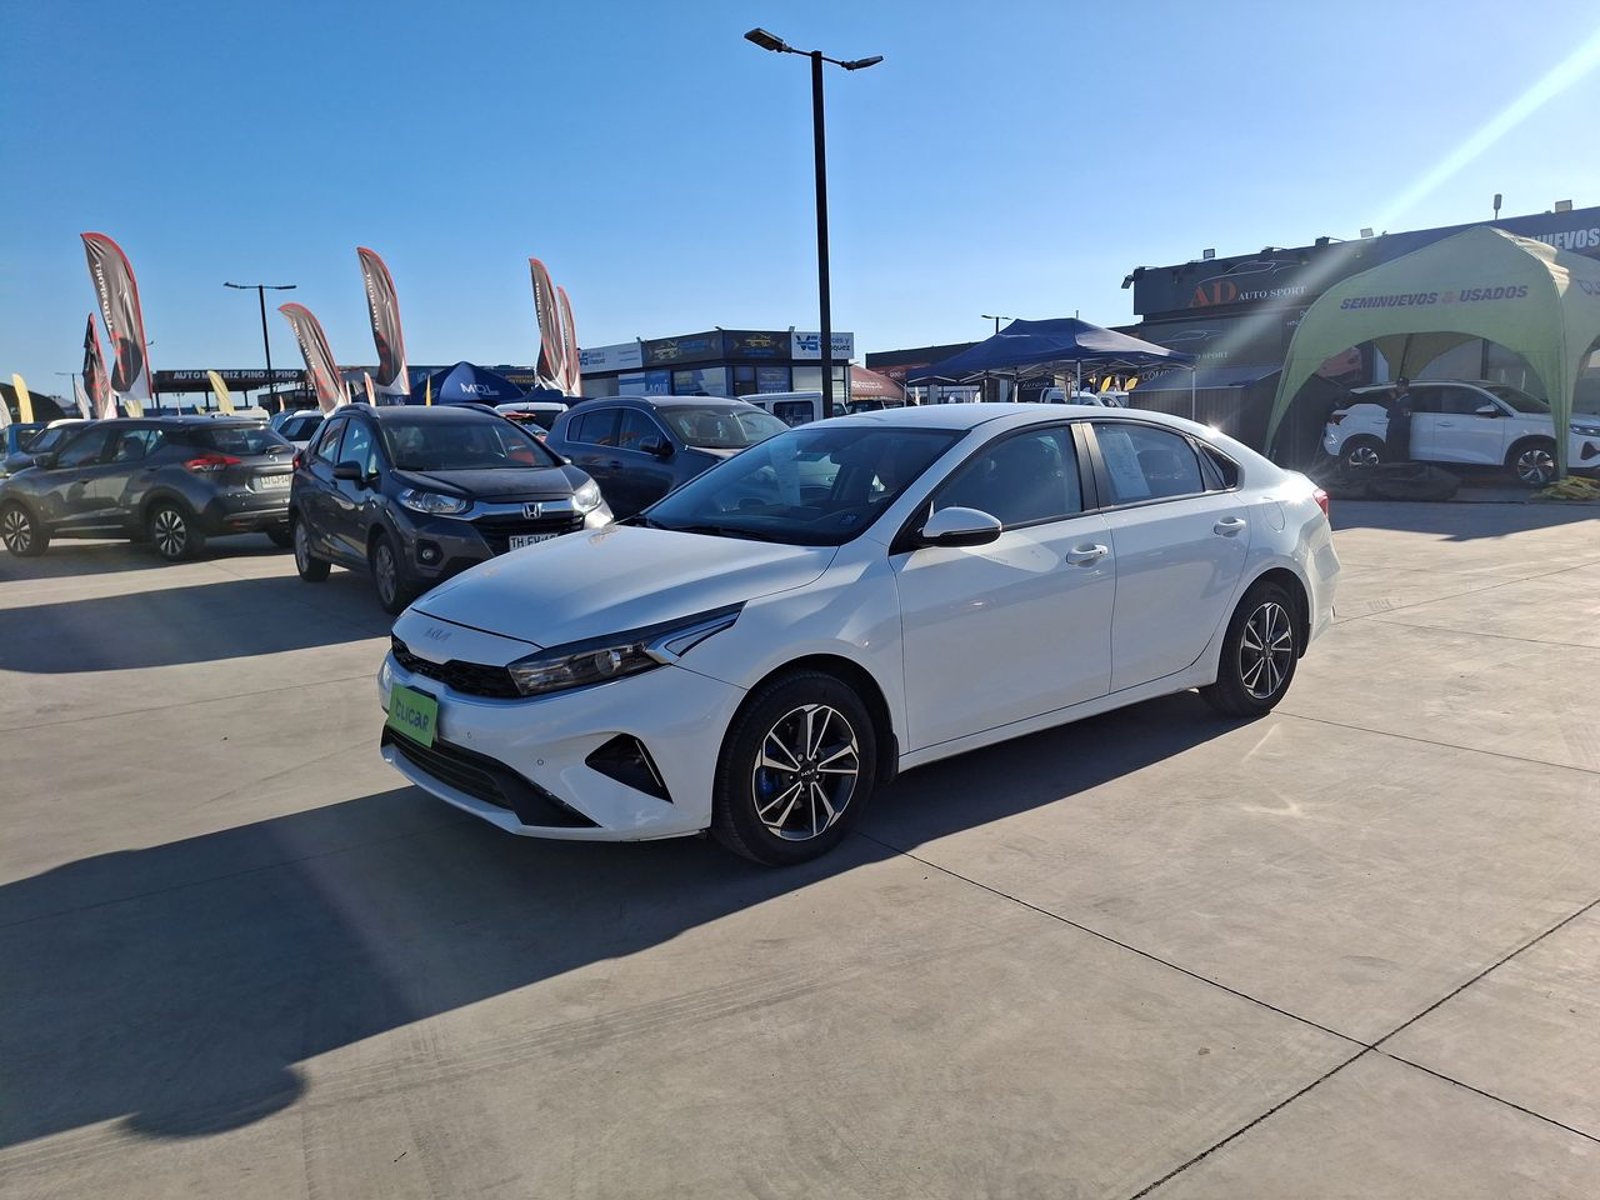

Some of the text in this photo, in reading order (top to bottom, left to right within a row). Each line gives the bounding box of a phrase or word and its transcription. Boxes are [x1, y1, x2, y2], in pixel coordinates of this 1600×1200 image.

[1188, 280, 1307, 308] AD AUTO SPORT
[1340, 292, 1438, 310] SEMINUEVOS
[1459, 285, 1529, 302] USADOS
[241, 370, 265, 379] PINO
[275, 370, 298, 379] PINO
